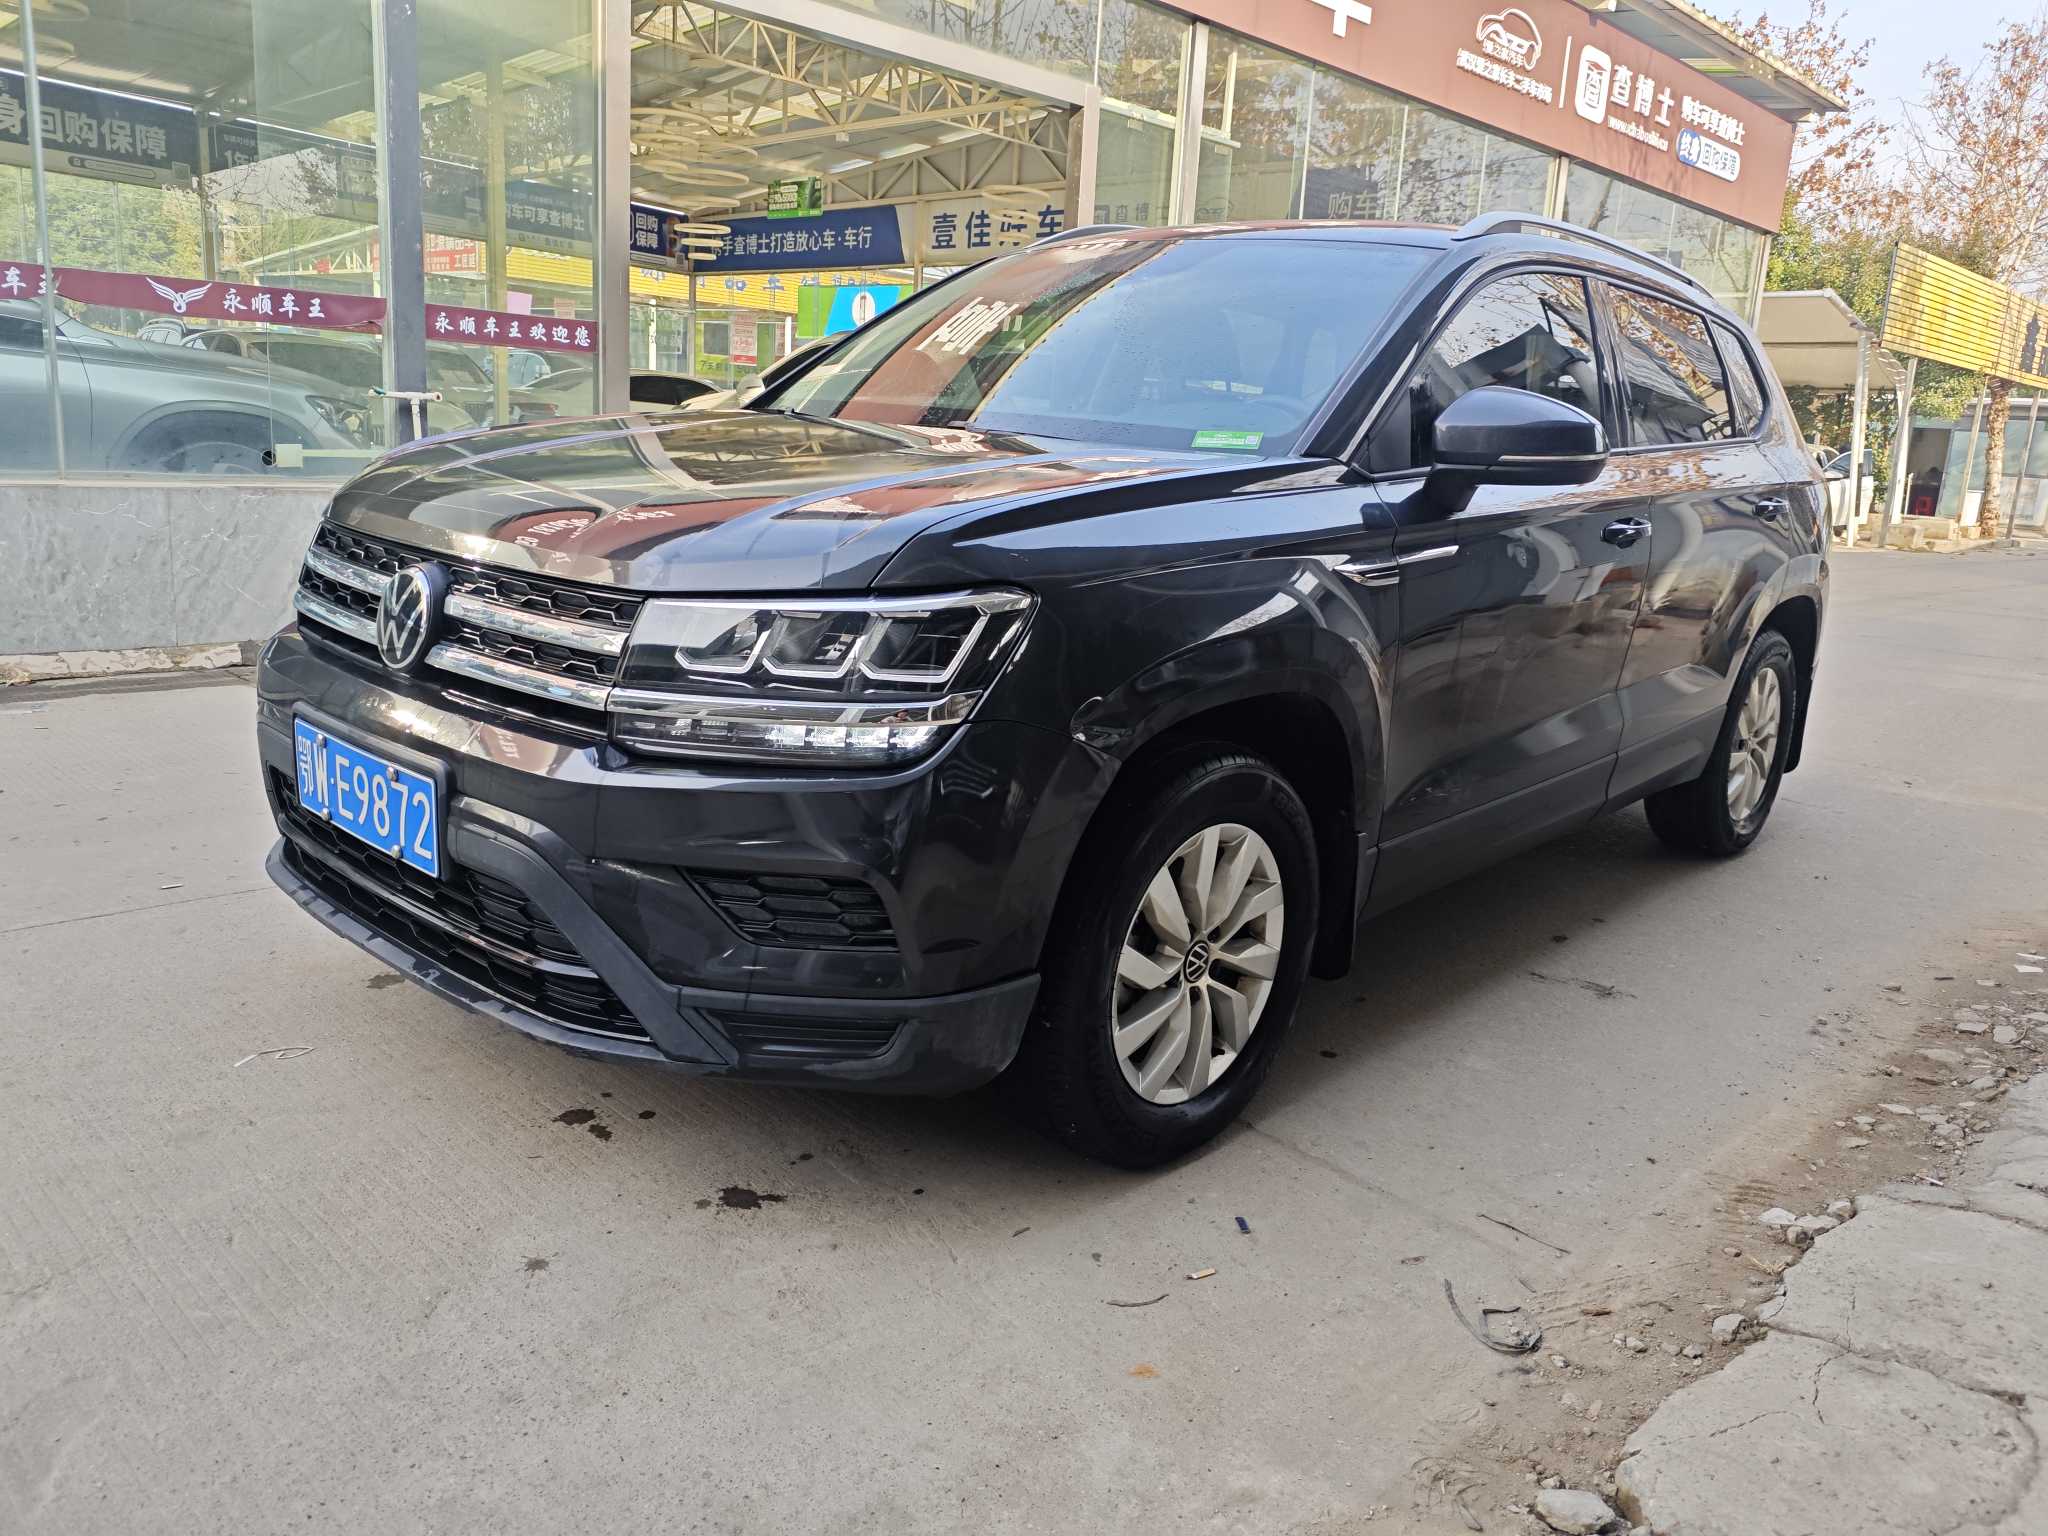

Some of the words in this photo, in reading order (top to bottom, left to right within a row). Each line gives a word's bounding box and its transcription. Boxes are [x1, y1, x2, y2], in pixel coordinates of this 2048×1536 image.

[1610, 65, 1675, 127] 查博士
[635, 212, 659, 232] 回购
[635, 231, 659, 249] 保障
[223, 288, 325, 319] 永顺车王
[435, 312, 591, 347] 永顺车王欢迎您
